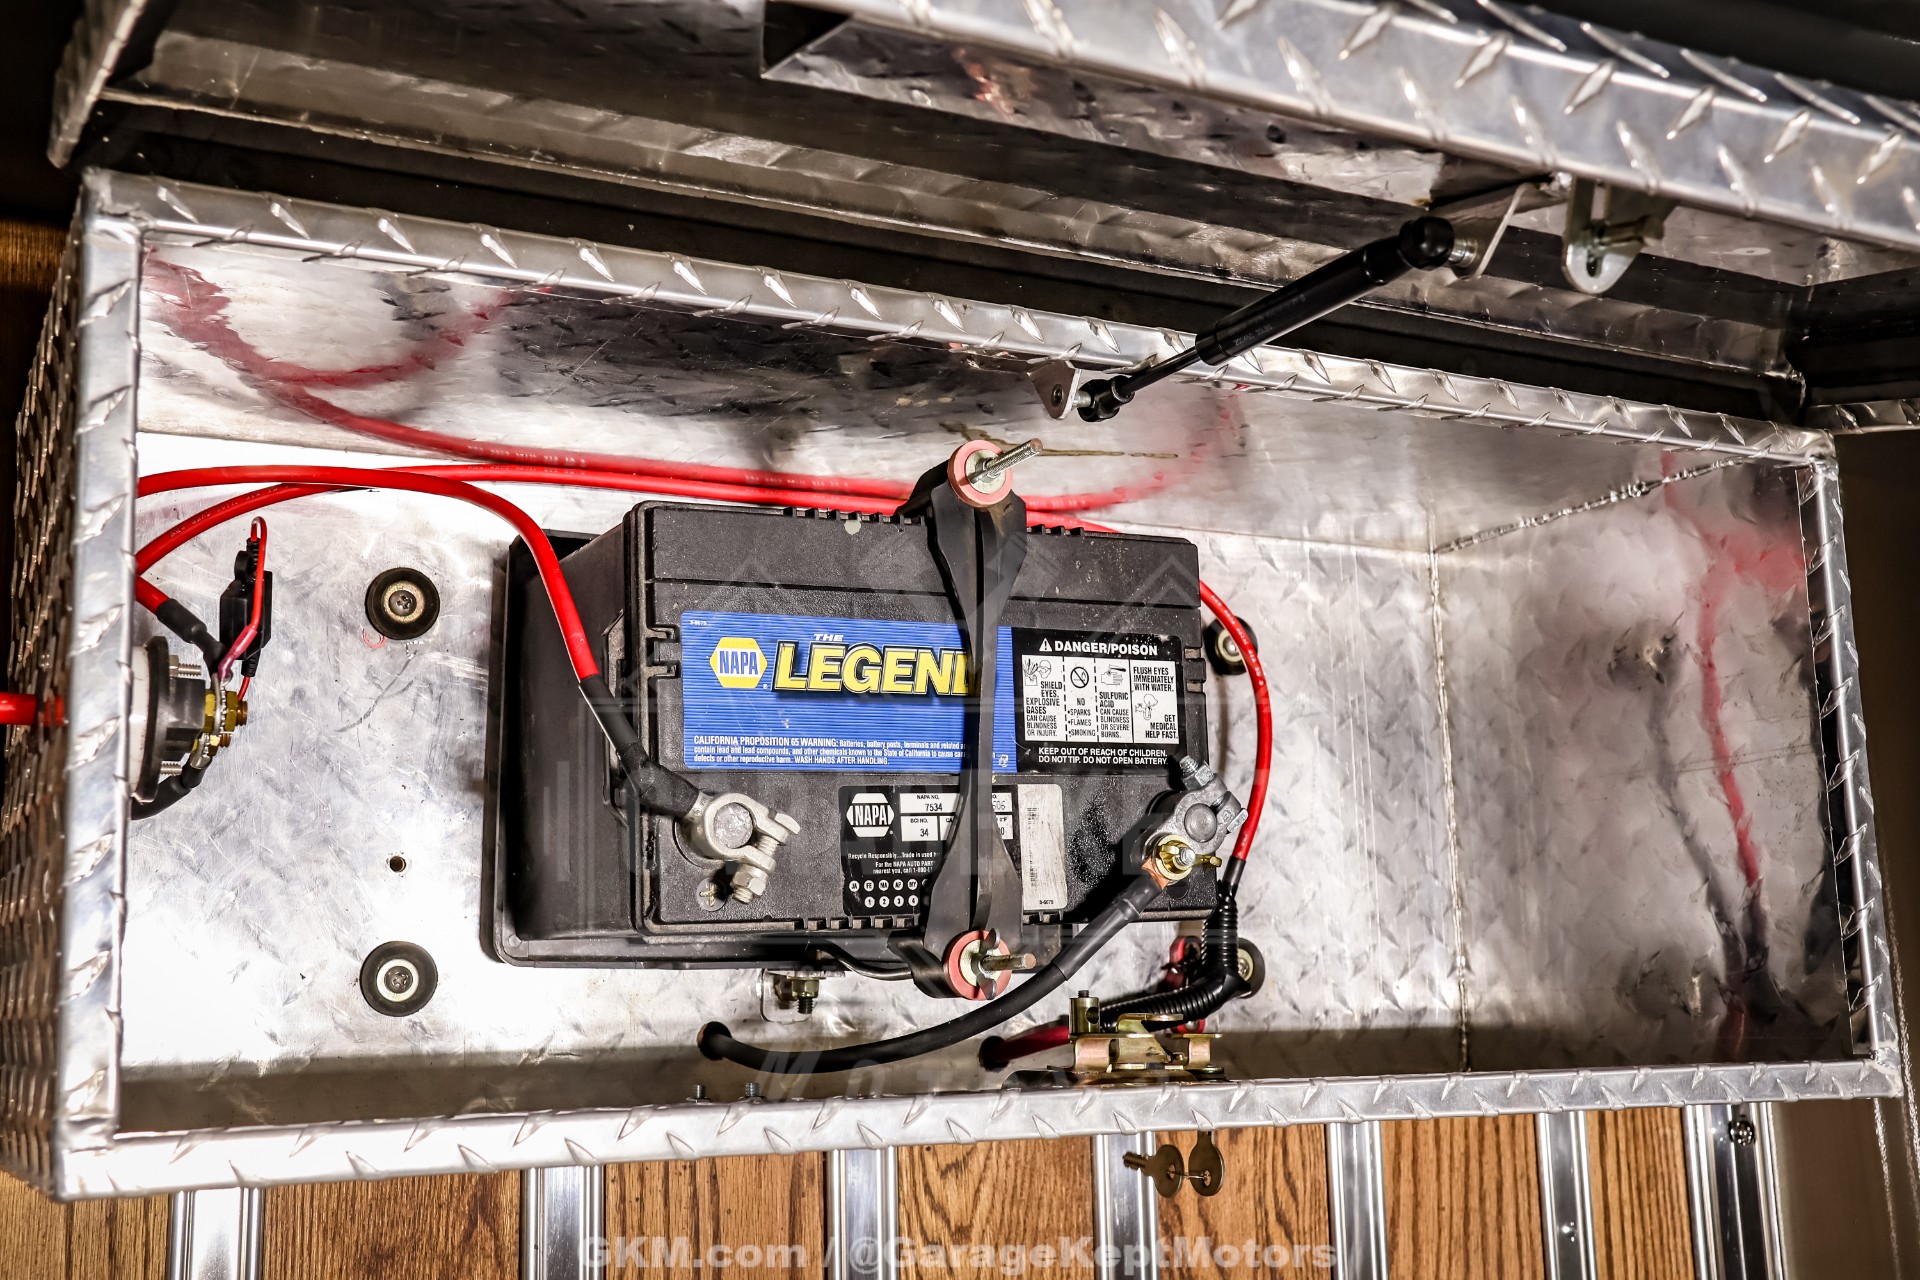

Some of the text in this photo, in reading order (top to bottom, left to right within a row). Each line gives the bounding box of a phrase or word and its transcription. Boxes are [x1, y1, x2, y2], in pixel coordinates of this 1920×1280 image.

[813, 633, 844, 642] THE
[1054, 640, 1158, 656] DANGER/POISON
[719, 650, 759, 675] NAPA
[1133, 666, 1169, 676] FLUSH EYES
[1133, 674, 1175, 684] IMMEDIATELY
[1040, 680, 1063, 690] SHIELD
[1133, 682, 1175, 692] WITH WATER.
[1041, 689, 1060, 698] EYES.
[1099, 691, 1129, 700] SULFURIC
[1025, 697, 1060, 707] EXPLOSIVE
[1076, 697, 1086, 706] NO
[1099, 700, 1115, 708] ACID
[1026, 706, 1047, 715] GASES
[1100, 708, 1129, 716] CAN CAUSE
[1026, 714, 1057, 723] CAN CAUSE
[1100, 715, 1130, 724] BLINDNESS
[1164, 714, 1176, 723] GET
[1026, 721, 1058, 730] BLINDNESS
[1100, 723, 1130, 731] OR SEVERE
[1149, 721, 1177, 731] MEDICAL
[1026, 729, 1058, 737] OR INJURY.
[1101, 730, 1122, 739] BURNS.
[1145, 730, 1179, 739] HELP FAST.
[693, 735, 739, 745] CALIFORNIA
[740, 736, 789, 746] PROPOSITION
[790, 737, 800, 747] 65
[800, 738, 839, 748] WARNING:
[866, 740, 886, 750] battery
[903, 741, 929, 749] terminals
[940, 742, 960, 750] related
[693, 745, 716, 754] contain
[716, 745, 730, 754] lead
[730, 746, 742, 754] and
[742, 746, 756, 755] lead
[791, 747, 803, 755] and
[803, 747, 819, 755] other
[819, 748, 848, 756] chemicals
[848, 748, 866, 757] known
[873, 748, 883, 757] the
[883, 749, 898, 757] State
[898, 749, 905, 757] of
[905, 749, 931, 758] California
[1038, 747, 1168, 757] KEEP OUT OF REACH OF CHILDREN.
[693, 753, 716, 762] defects
[723, 754, 740, 763] other
[739, 755, 775, 764] reproductive
[794, 755, 813, 764] WASH
[814, 756, 836, 765] HANDS
[836, 756, 856, 765] AFTER
[857, 756, 890, 765] HANDLING.
[1038, 755, 1168, 765] DO NOT TIP. DO NOT OPEN BATTERY.
[924, 803, 943, 812] 7534
[854, 804, 888, 826] NAPA
[919, 828, 929, 837] 34
[847, 852, 867, 860] Recycle
